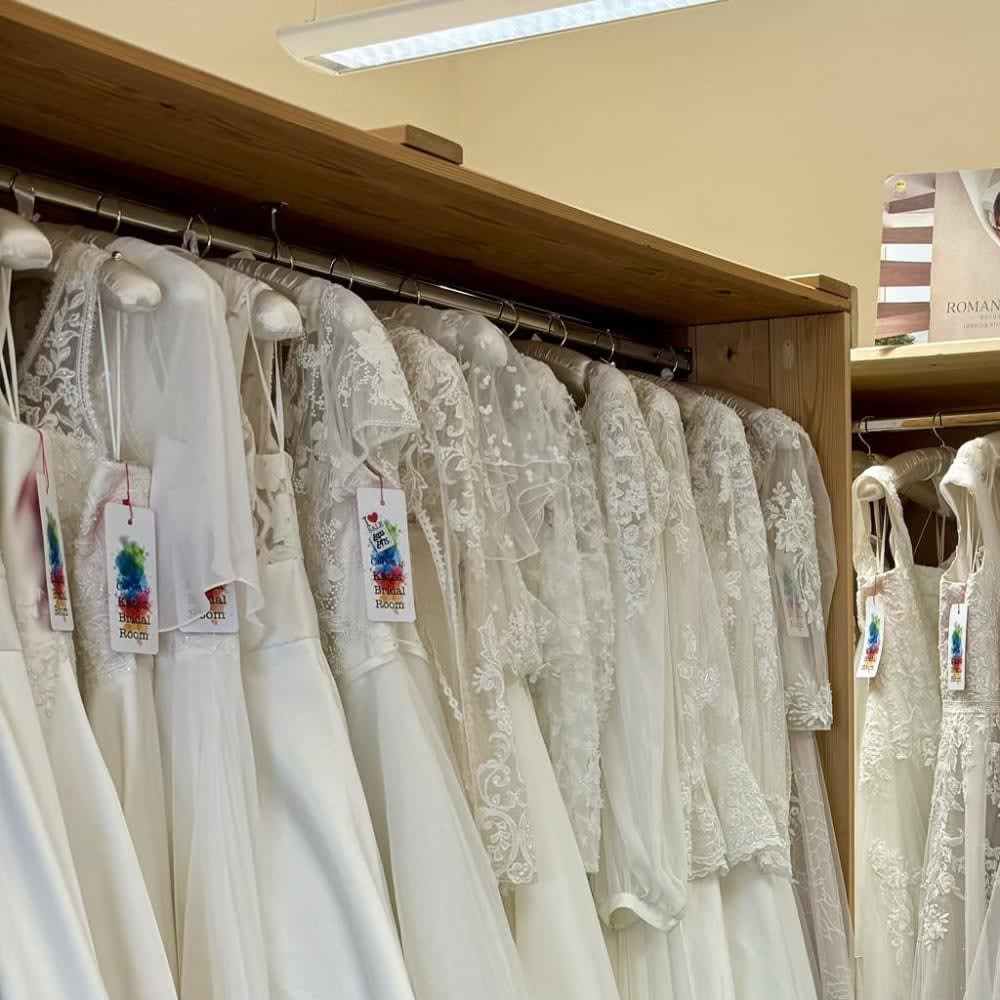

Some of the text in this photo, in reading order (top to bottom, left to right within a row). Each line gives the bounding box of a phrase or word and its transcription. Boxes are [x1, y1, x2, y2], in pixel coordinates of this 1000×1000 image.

[374, 585, 405, 596] Bridal
[376, 600, 405, 610] Room
[119, 612, 151, 625] Bridal
[120, 628, 149, 641] Room
